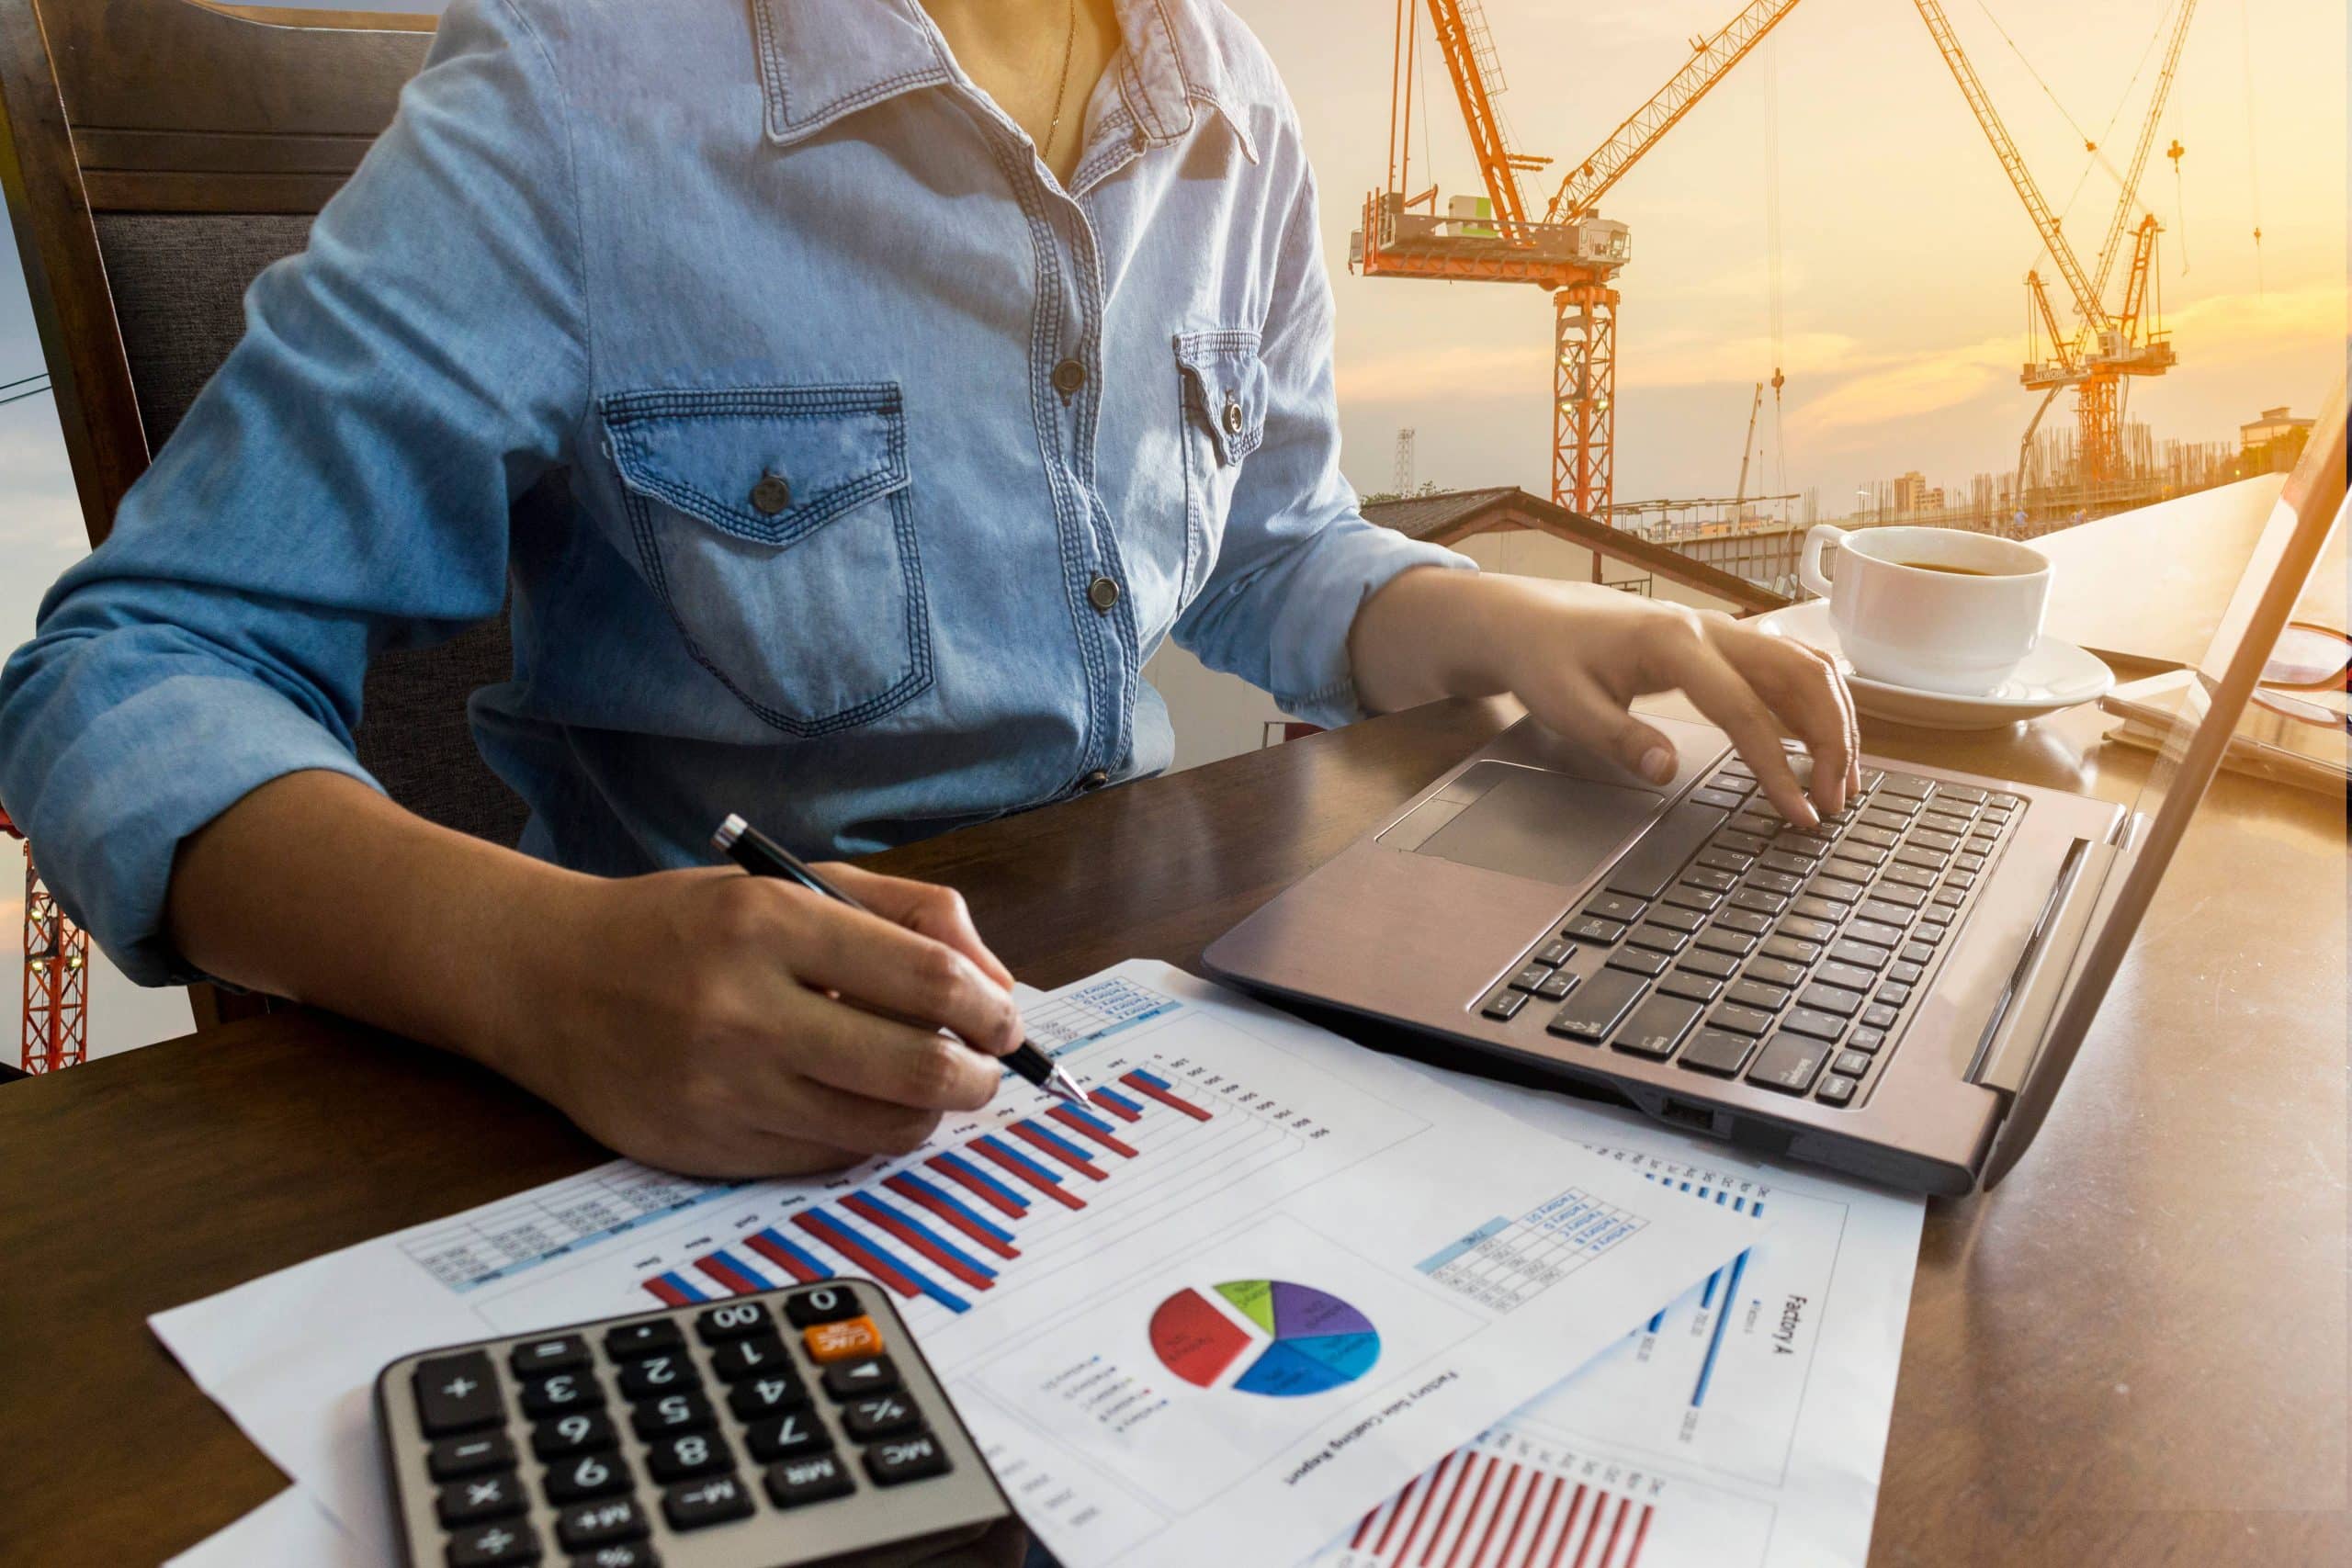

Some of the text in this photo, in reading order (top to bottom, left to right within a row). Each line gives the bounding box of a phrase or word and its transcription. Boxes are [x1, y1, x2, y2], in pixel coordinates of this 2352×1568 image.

[809, 1290, 838, 1311] 0
[713, 1304, 760, 1328] 00
[1771, 1293, 1809, 1356] Factory A
[740, 1342, 763, 1366] 1
[642, 1357, 677, 1384] 2
[443, 1375, 478, 1398] +
[544, 1375, 578, 1403] 3
[755, 1380, 786, 1404] 4
[659, 1395, 691, 1425] 5
[557, 1416, 591, 1445] 6
[778, 1416, 808, 1445] 7
[673, 1435, 710, 1467] 8
[883, 1441, 933, 1465] MC
[574, 1456, 609, 1487] 9
[786, 1460, 836, 1486] MR
[575, 1502, 632, 1530] M+
